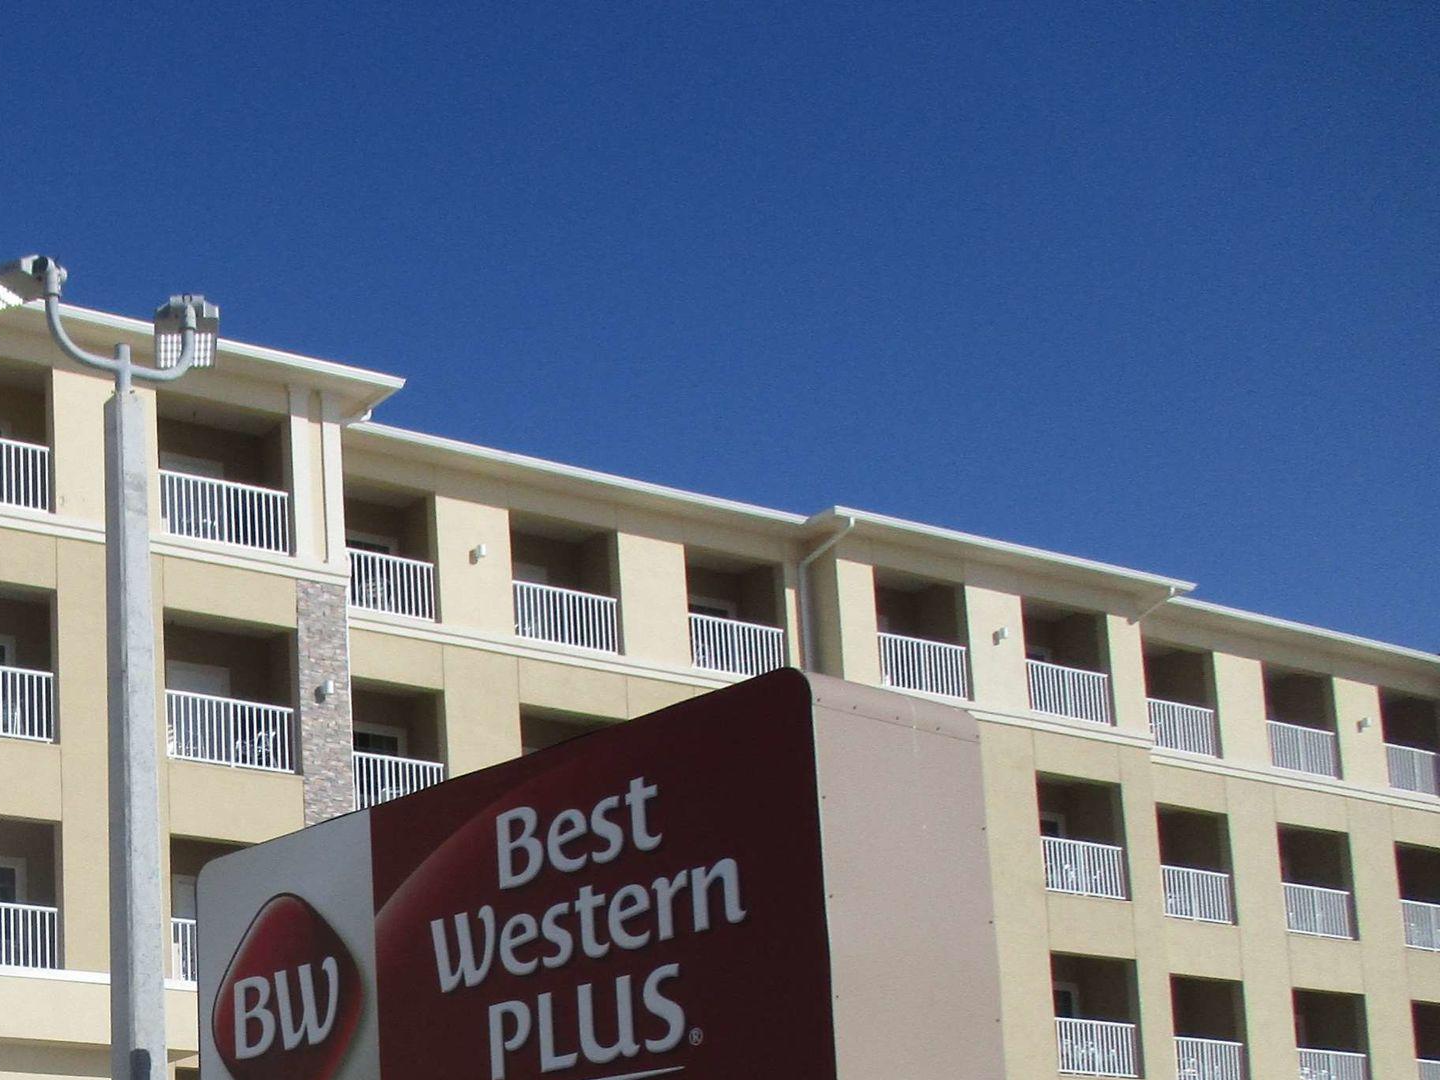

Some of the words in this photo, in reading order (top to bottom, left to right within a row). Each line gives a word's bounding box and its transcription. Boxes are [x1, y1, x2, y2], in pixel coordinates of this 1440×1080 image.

[495, 775, 663, 890] Best
[429, 857, 748, 994] Western
[233, 955, 340, 1060] BW
